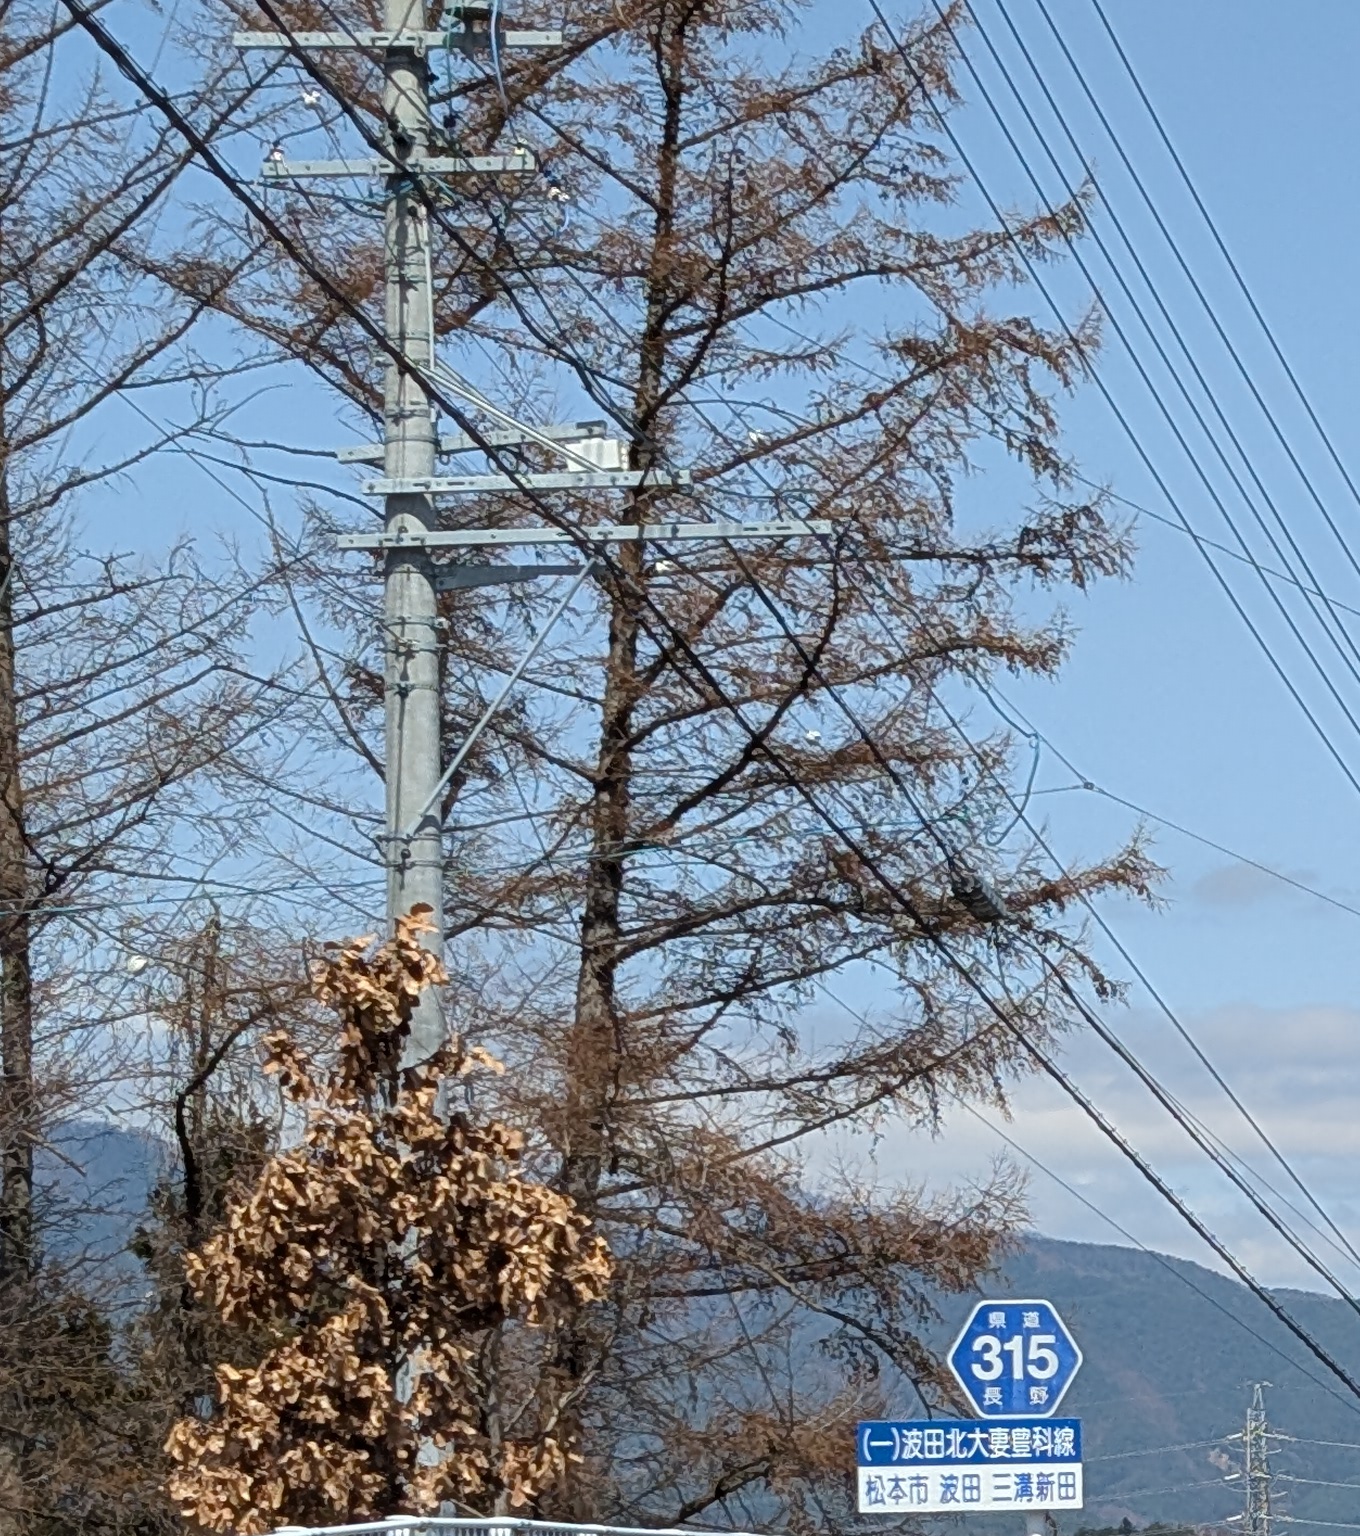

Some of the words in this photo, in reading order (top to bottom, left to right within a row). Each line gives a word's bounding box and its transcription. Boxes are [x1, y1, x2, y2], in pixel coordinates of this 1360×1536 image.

[988, 1311, 1040, 1329] 県道
[971, 1334, 1059, 1381] 315
[982, 1386, 1048, 1406] 長野
[865, 1473, 929, 1506] 松本市
[940, 1473, 981, 1503] 波田
[992, 1471, 1076, 1502] 三溝新田
